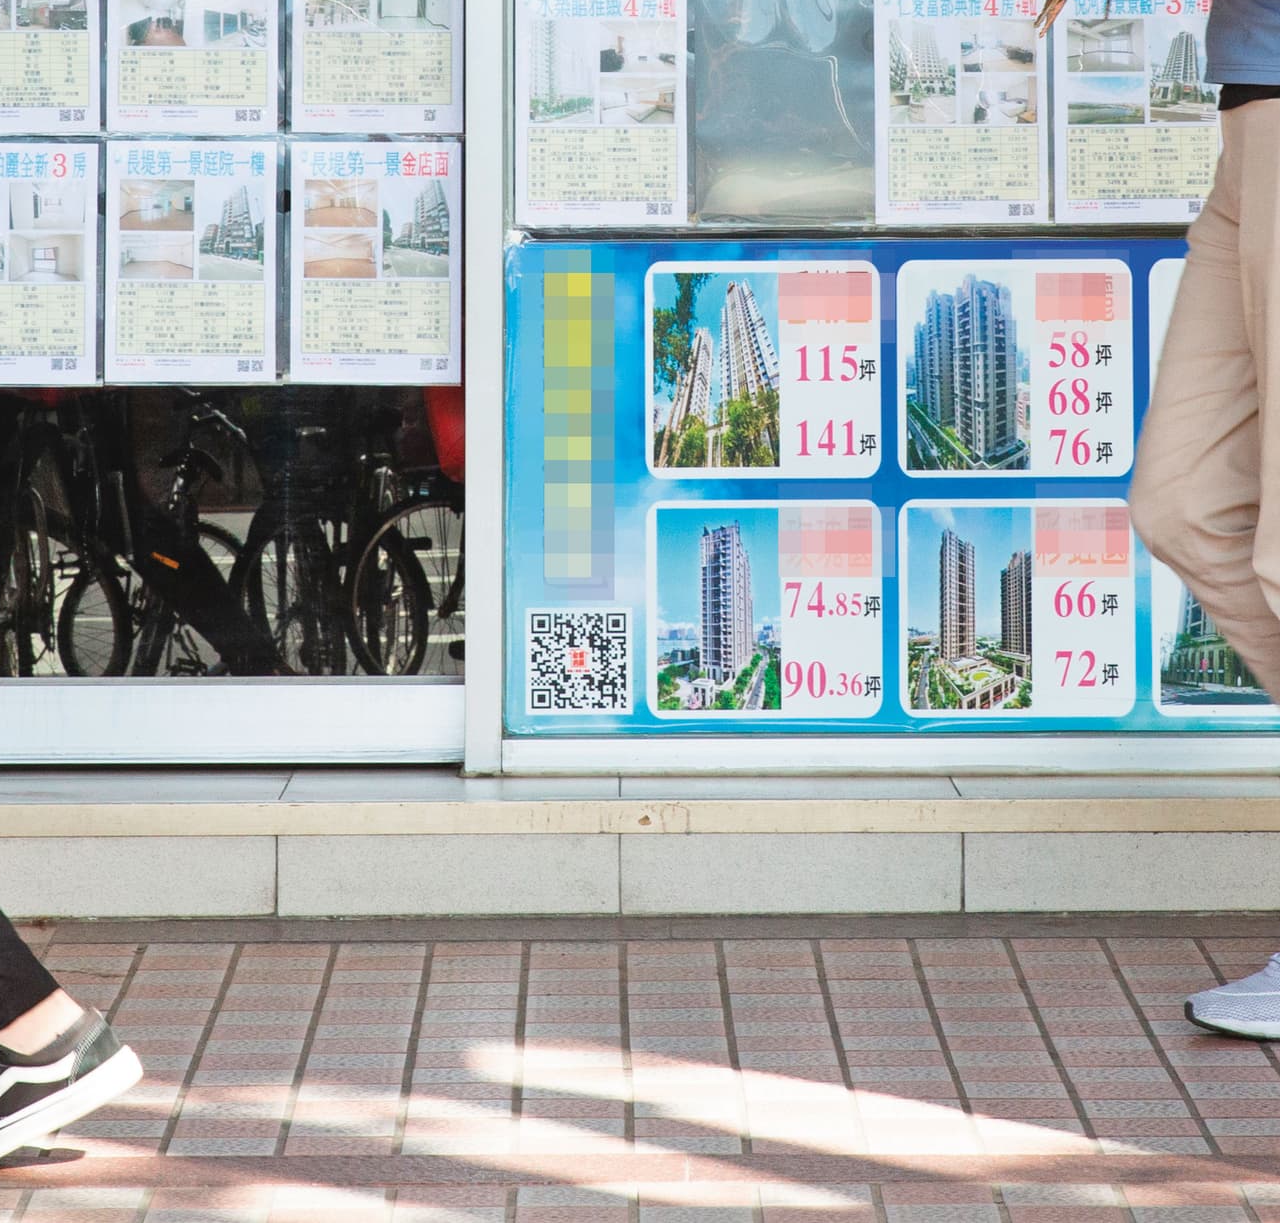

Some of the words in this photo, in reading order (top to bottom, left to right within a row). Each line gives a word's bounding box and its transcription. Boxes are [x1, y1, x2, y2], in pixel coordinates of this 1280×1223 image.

[794, 344, 877, 382] 115坪
[1048, 330, 1113, 368] 58坪
[1048, 377, 1113, 416] 68坪
[795, 419, 878, 457] 141坪
[1048, 428, 1114, 466] 76坪
[784, 581, 881, 618] 74.85坪
[1053, 580, 1119, 618] 66坪
[784, 660, 882, 699] 90.36坪
[1054, 650, 1120, 687] 72坪
